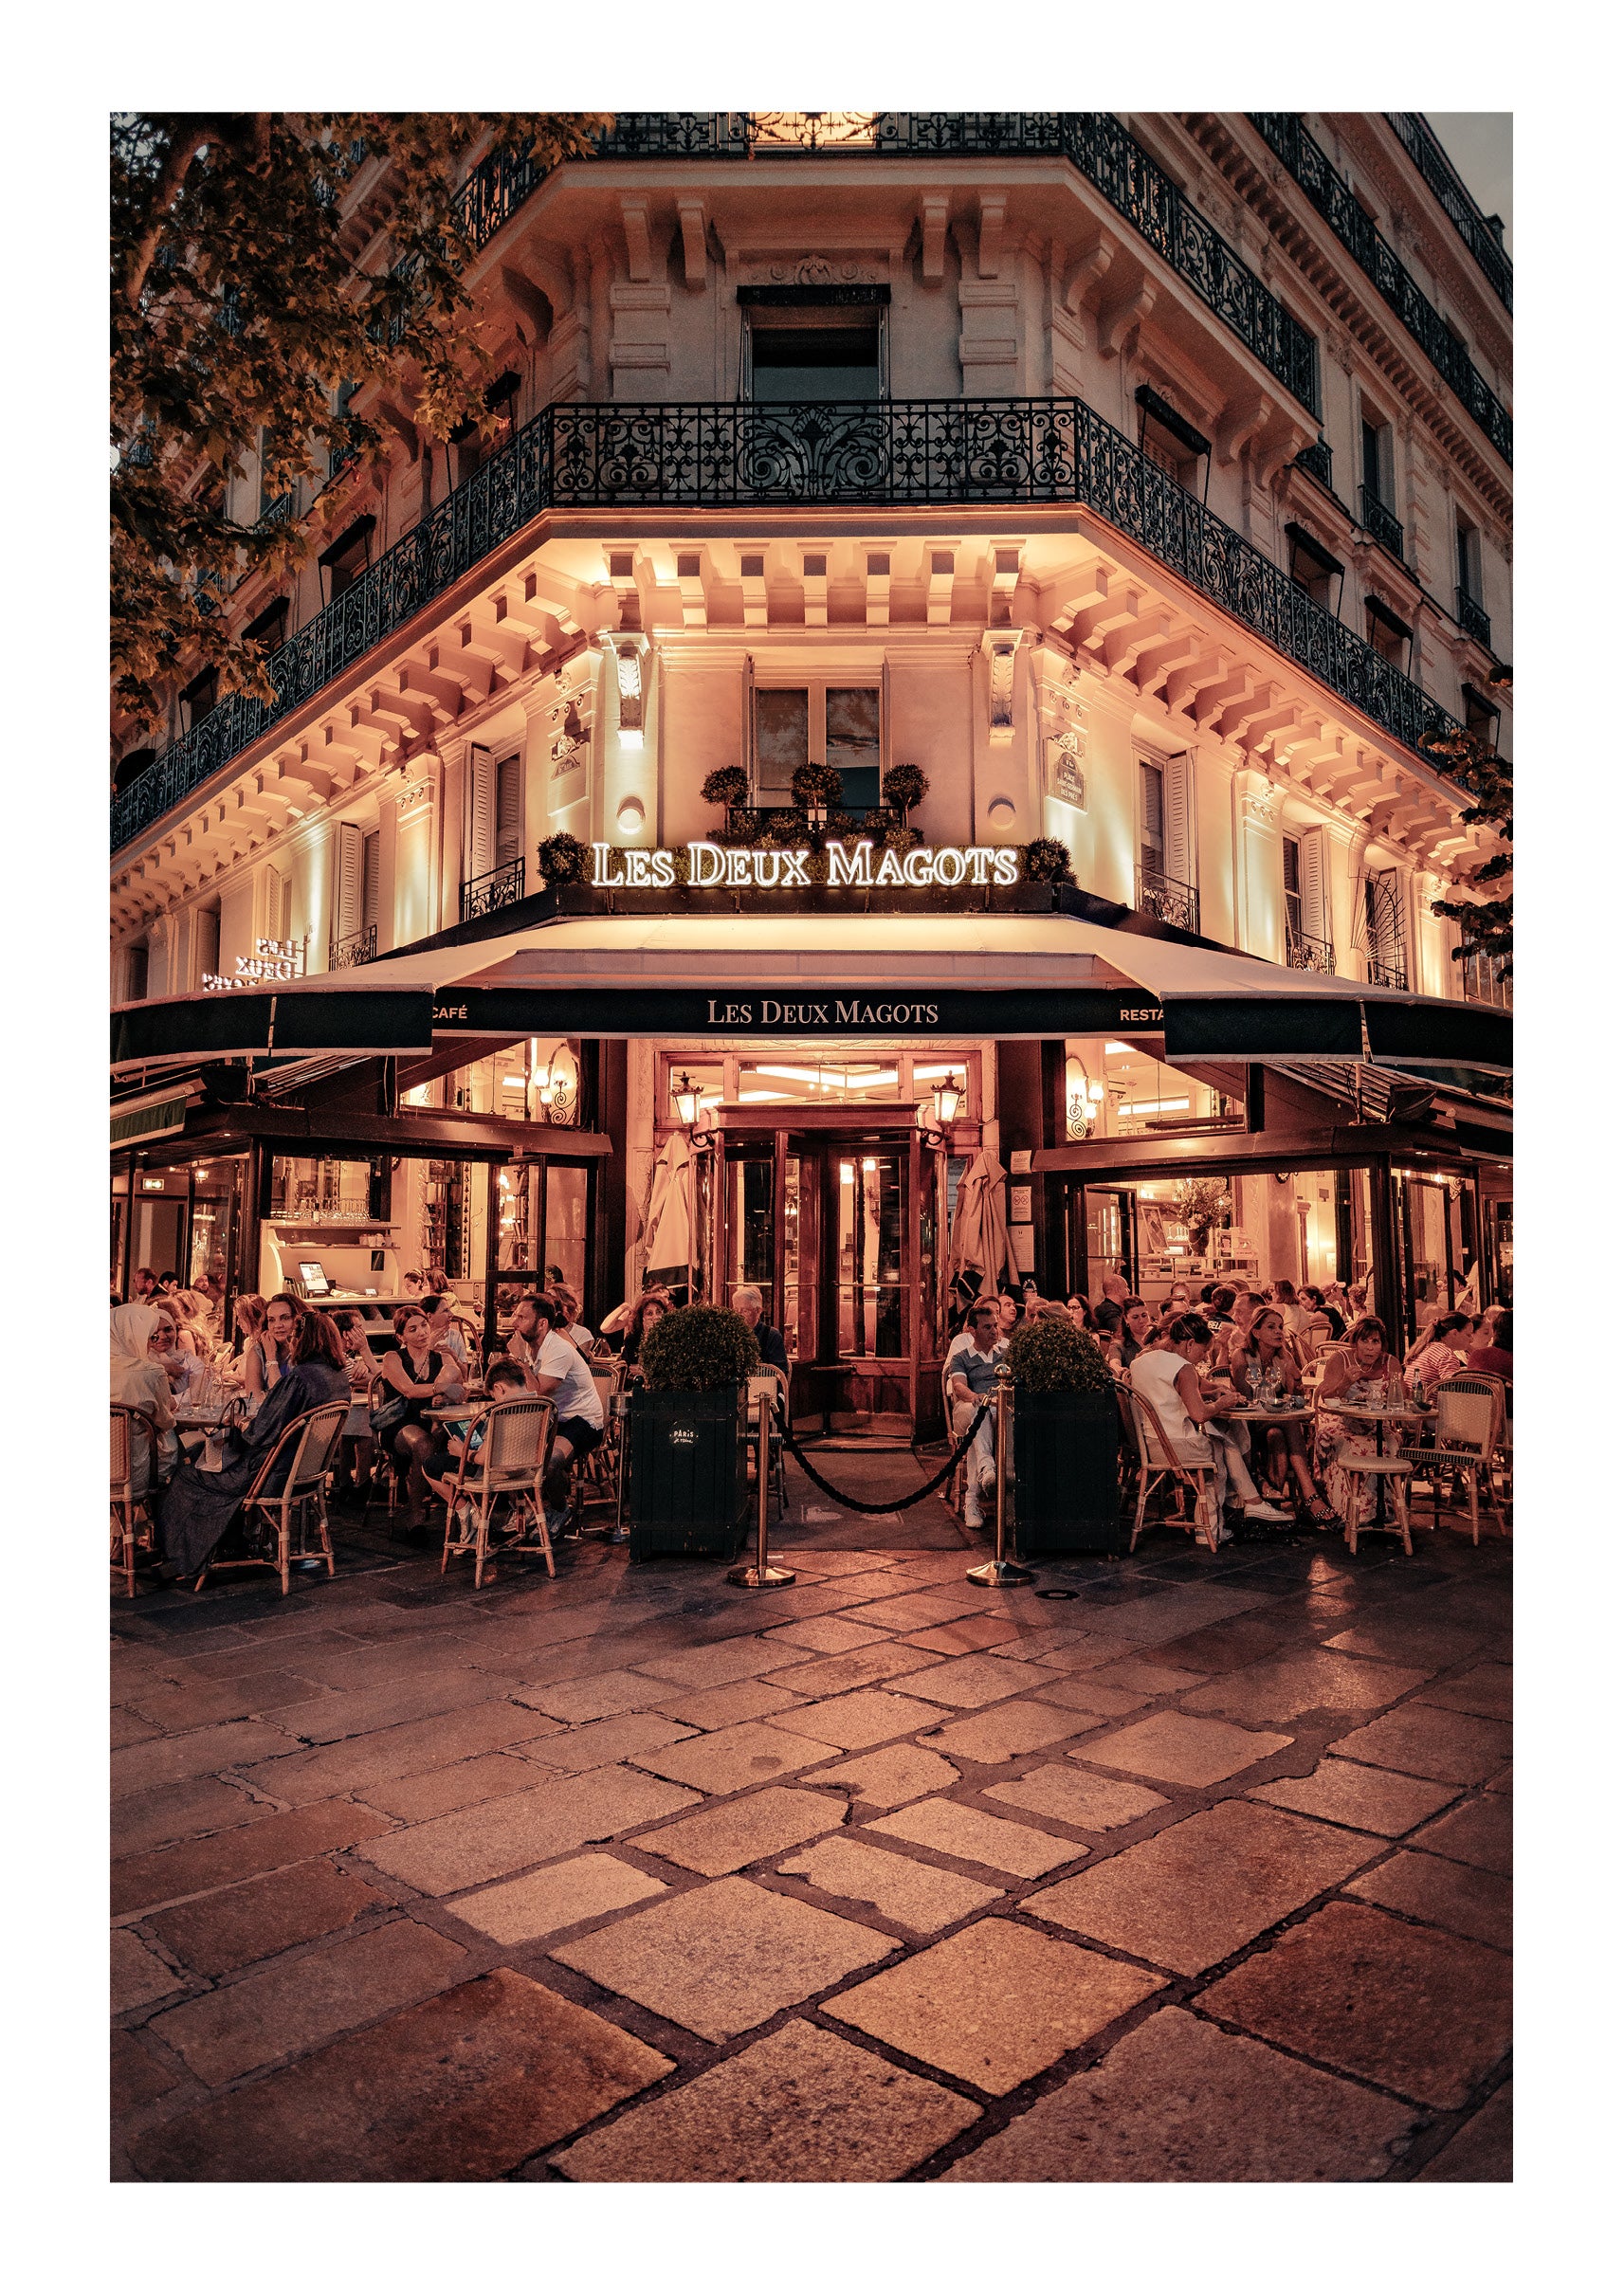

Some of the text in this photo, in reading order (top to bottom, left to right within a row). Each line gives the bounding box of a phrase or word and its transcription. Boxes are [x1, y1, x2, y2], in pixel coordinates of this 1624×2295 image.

[592, 842, 1019, 887] LES DEUX MAGOTS
[432, 1004, 468, 1019] CAFÉ
[707, 1000, 939, 1024] LES DEUX MAGOTS
